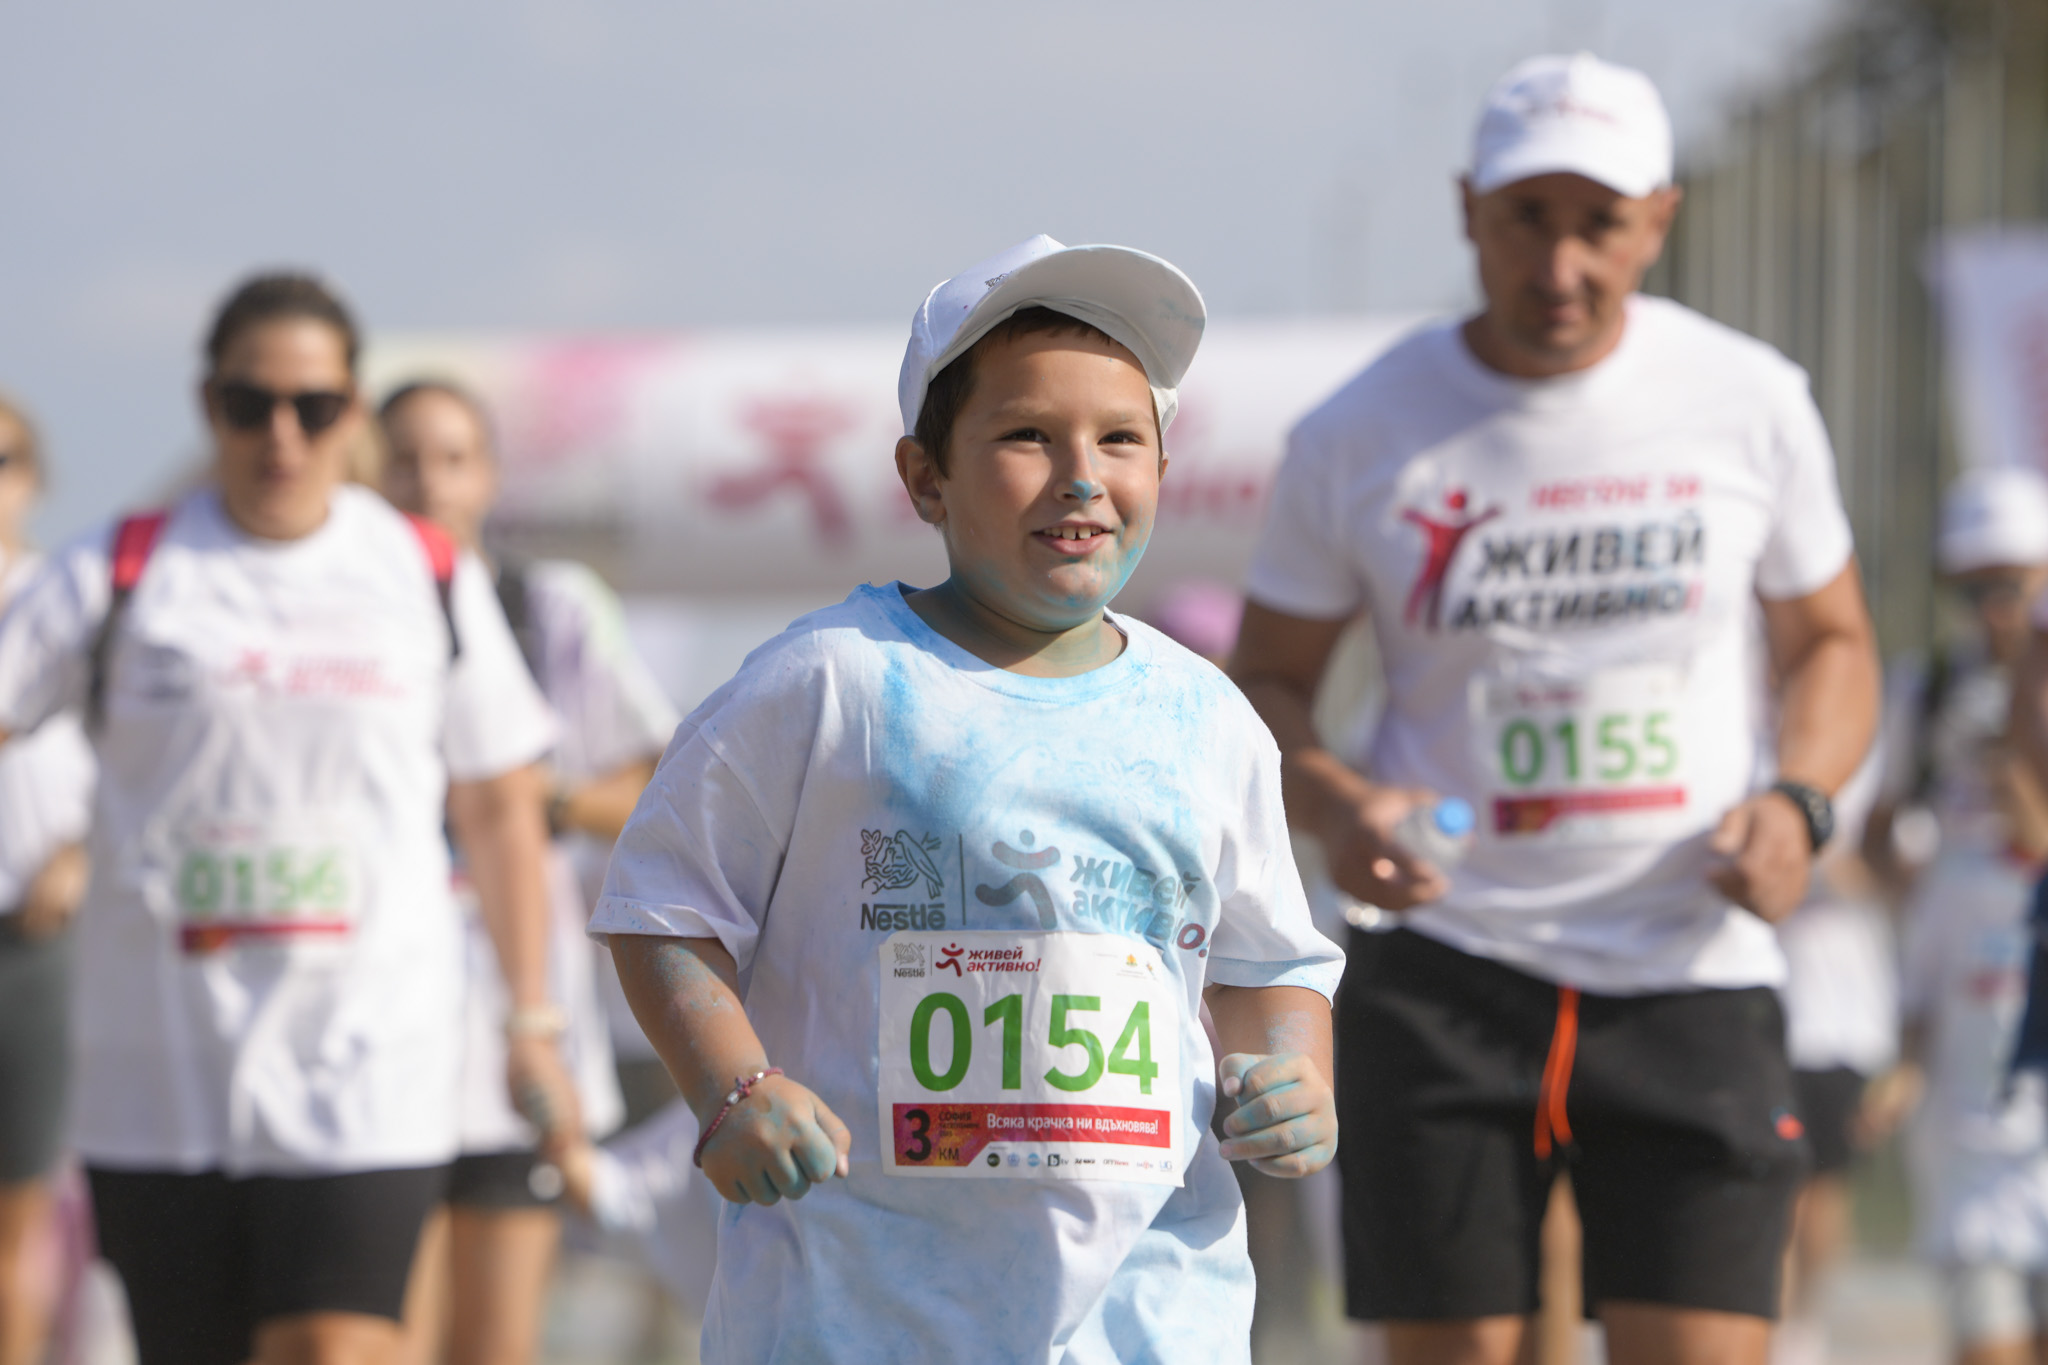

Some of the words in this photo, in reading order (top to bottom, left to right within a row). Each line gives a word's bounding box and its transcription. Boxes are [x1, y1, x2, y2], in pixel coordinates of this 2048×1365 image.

[1478, 509, 1704, 578] ЖИВЕЙ
[1500, 711, 1679, 786] 0155
[178, 845, 347, 916] 0156
[967, 958, 1042, 972] активно!
[968, 946, 1023, 960] живей
[909, 991, 1158, 1095] 0154
[905, 1109, 932, 1162] 3
[987, 1113, 1025, 1129] Всяка
[1027, 1117, 1073, 1132] крачка
[1076, 1117, 1092, 1129] ни
[1095, 1117, 1158, 1135] вдъхновява!
